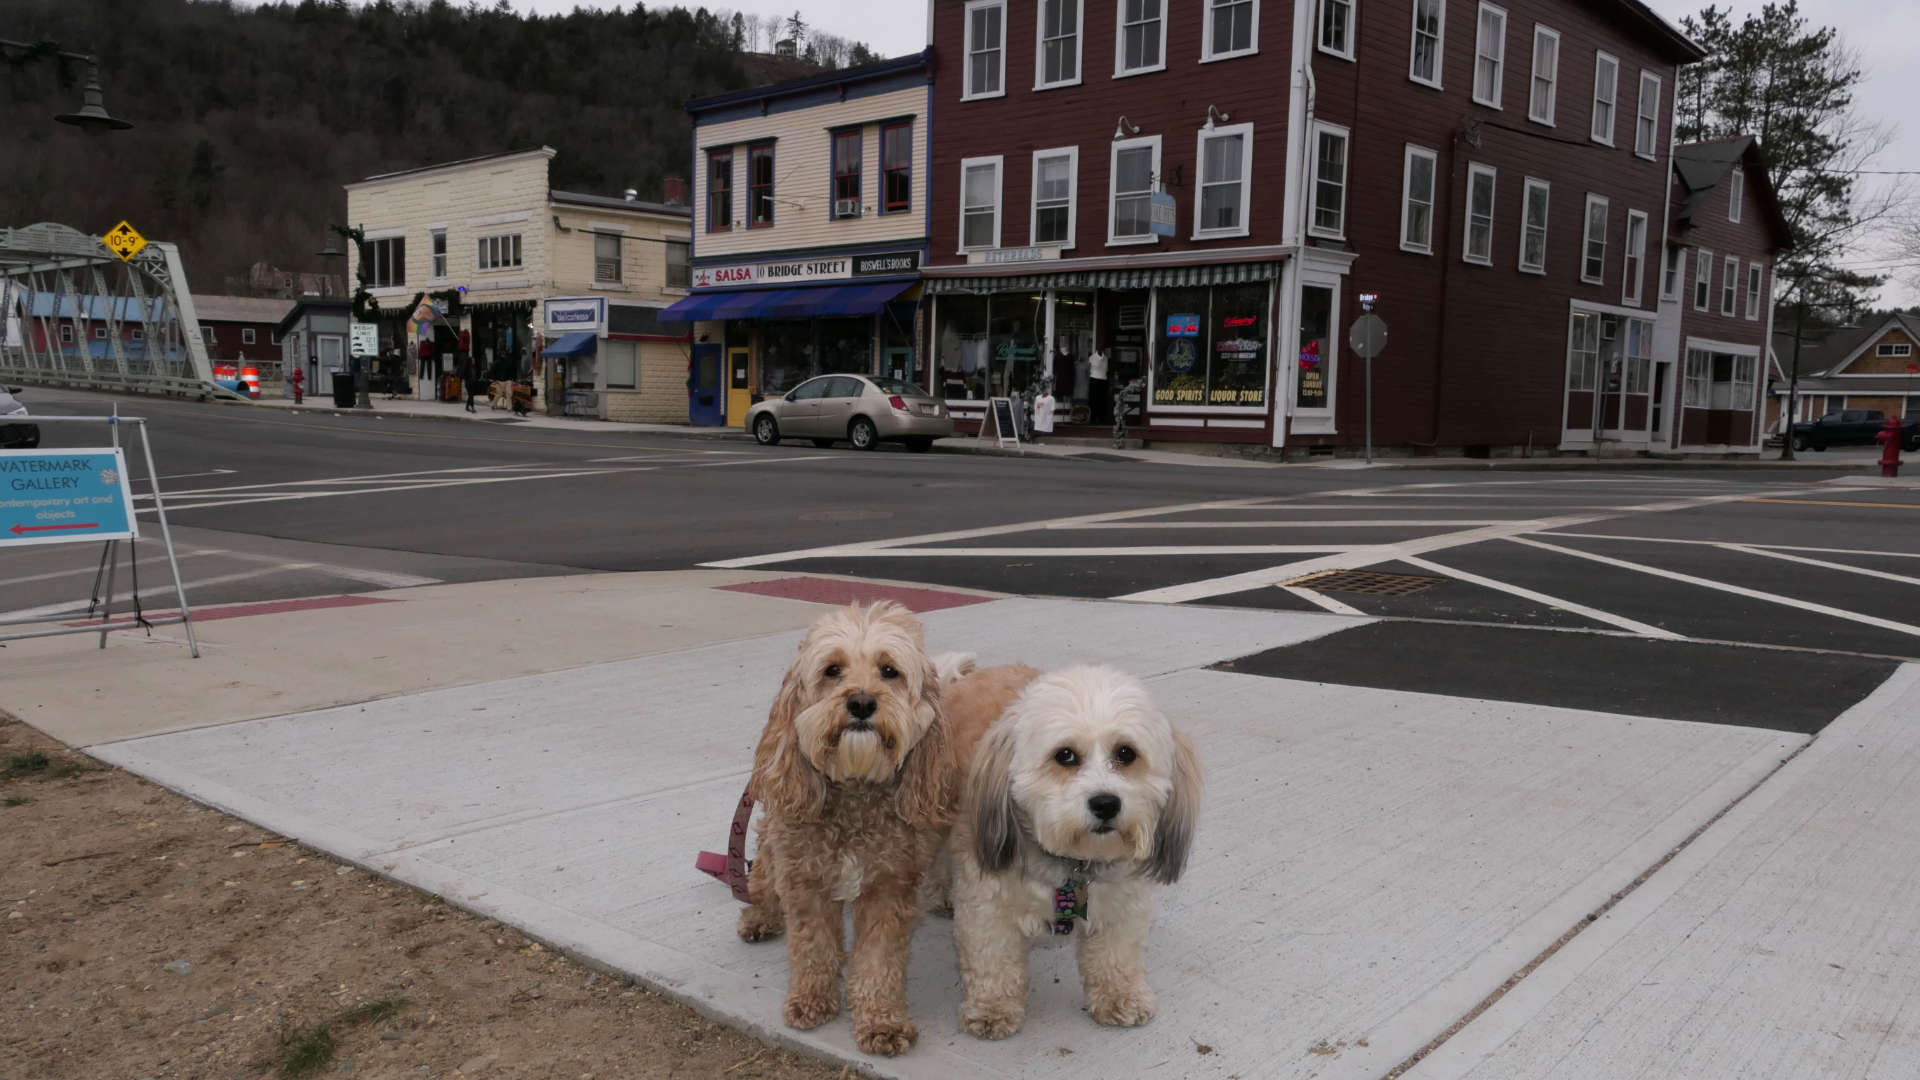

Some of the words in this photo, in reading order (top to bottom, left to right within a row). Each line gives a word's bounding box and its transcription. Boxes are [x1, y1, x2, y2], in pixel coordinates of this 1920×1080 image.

[767, 264, 803, 277] BRIDGE
[806, 261, 846, 275] STREET
[891, 257, 912, 270] BOOKS
[715, 267, 752, 281] SALSA
[1155, 390, 1175, 401] GOOD
[1177, 390, 1203, 401] SPIRITS
[1210, 390, 1237, 402] LIQUOR
[1239, 390, 1263, 402] STORE
[11, 477, 80, 490] GALLERY
[73, 496, 89, 505] art
[92, 493, 113, 504] and
[35, 509, 76, 520] objects
